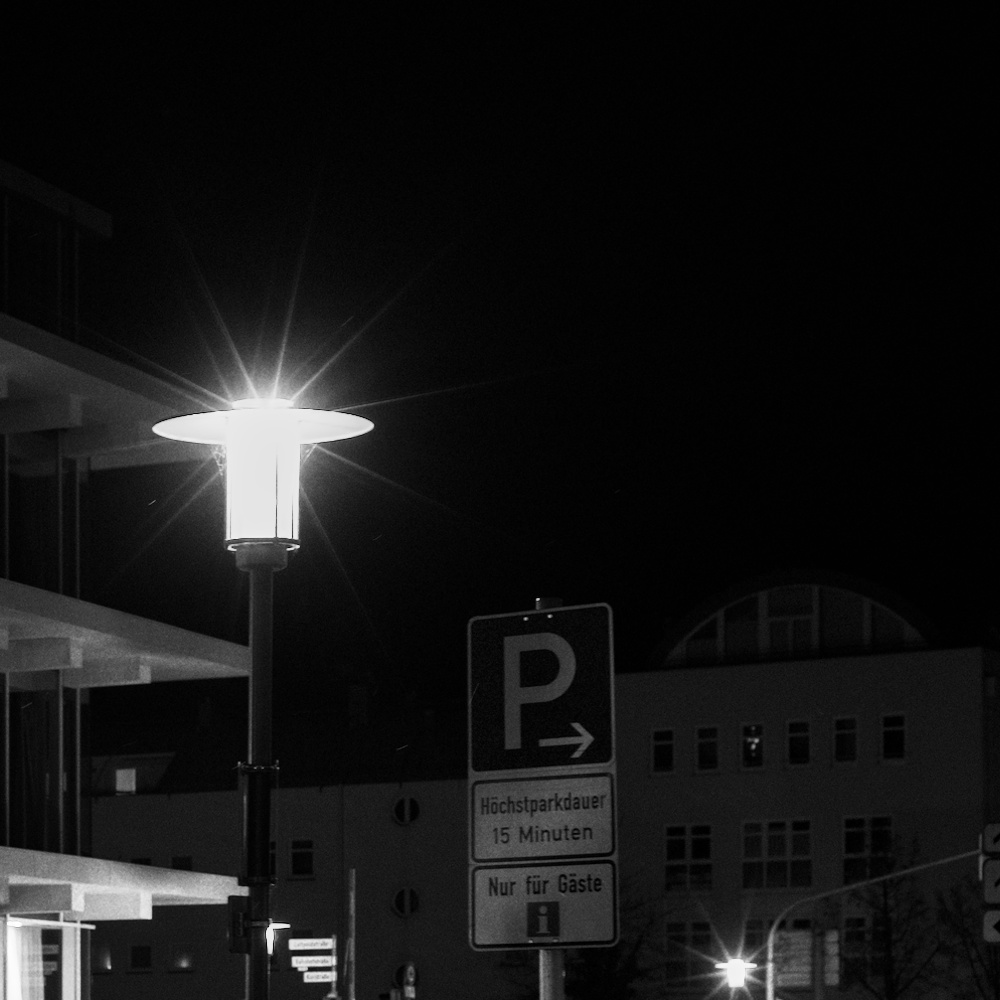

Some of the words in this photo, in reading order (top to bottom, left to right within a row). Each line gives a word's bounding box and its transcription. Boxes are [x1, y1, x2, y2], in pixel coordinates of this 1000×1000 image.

[503, 632, 577, 751] P
[480, 791, 607, 818] Höchstparkdauer
[492, 826, 511, 845] 15
[518, 825, 594, 844] Minuten
[488, 876, 516, 897] Nur
[525, 874, 550, 895] für
[557, 873, 602, 894] Gäste
